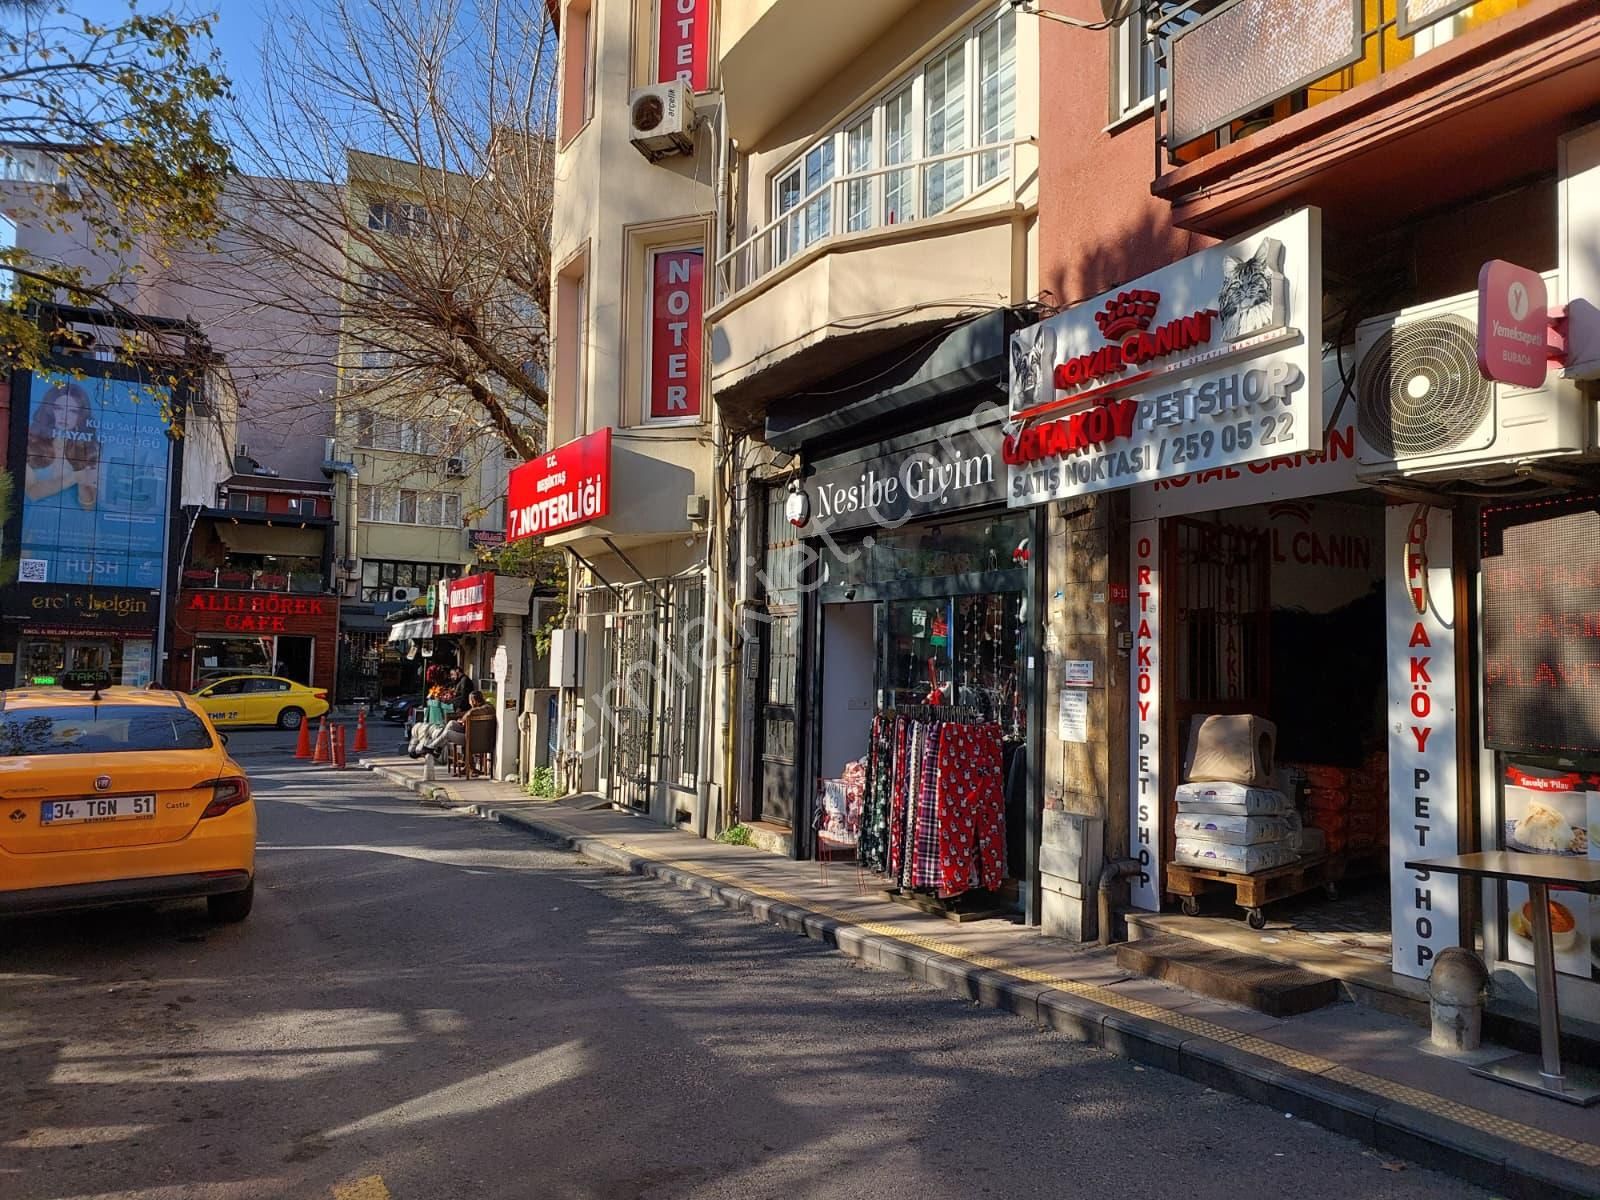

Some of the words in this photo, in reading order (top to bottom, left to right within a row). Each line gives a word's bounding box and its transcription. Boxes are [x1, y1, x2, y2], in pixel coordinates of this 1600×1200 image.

[667, 258, 690, 411] NOTER
[1054, 345, 1127, 391] ROYAL
[1120, 308, 1217, 366] CANIN
[1492, 319, 1542, 346] Yemeksepeti
[1503, 350, 1532, 365] BURADA
[52, 429, 94, 442] HAYAT
[1003, 398, 1138, 466] ORTAKÖY
[1012, 468, 1060, 497] SATIŞ
[1064, 443, 1152, 488] NOKTASI
[1156, 439, 1167, 470] /
[1172, 430, 1214, 465] 259
[1221, 420, 1253, 453] 05
[1260, 411, 1294, 446] 22
[817, 470, 898, 519] Nesibe
[906, 451, 996, 505] Giyim
[66, 558, 119, 574] HUSH
[1293, 532, 1371, 570] CANIN
[1137, 537, 1151, 722] ORTAKÖY
[1138, 733, 1150, 795] PET
[1550, 780, 1569, 790] Pilav
[54, 803, 75, 819] 34
[87, 801, 117, 816] TGN
[134, 798, 151, 813] 51
[1414, 768, 1430, 847] PET
[1138, 805, 1150, 889] SHOP
